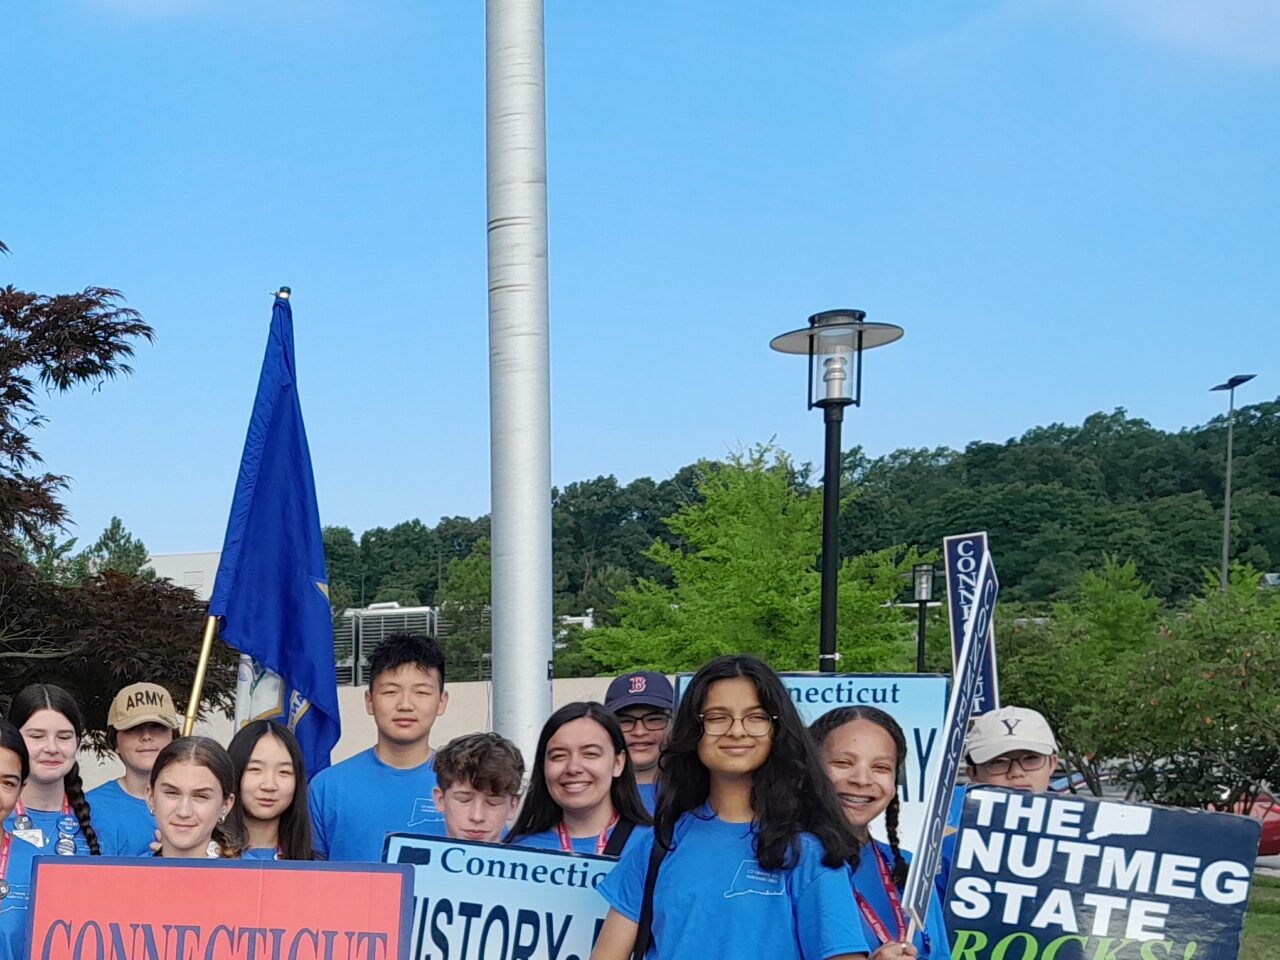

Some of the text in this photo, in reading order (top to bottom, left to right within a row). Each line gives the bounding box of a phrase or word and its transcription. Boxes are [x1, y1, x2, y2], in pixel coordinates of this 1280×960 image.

[126, 690, 164, 711] ARMY
[1001, 718, 1023, 736] Y
[969, 790, 1085, 838] THE
[956, 828, 1250, 905] NUTMEG
[950, 876, 1170, 941] STATE
